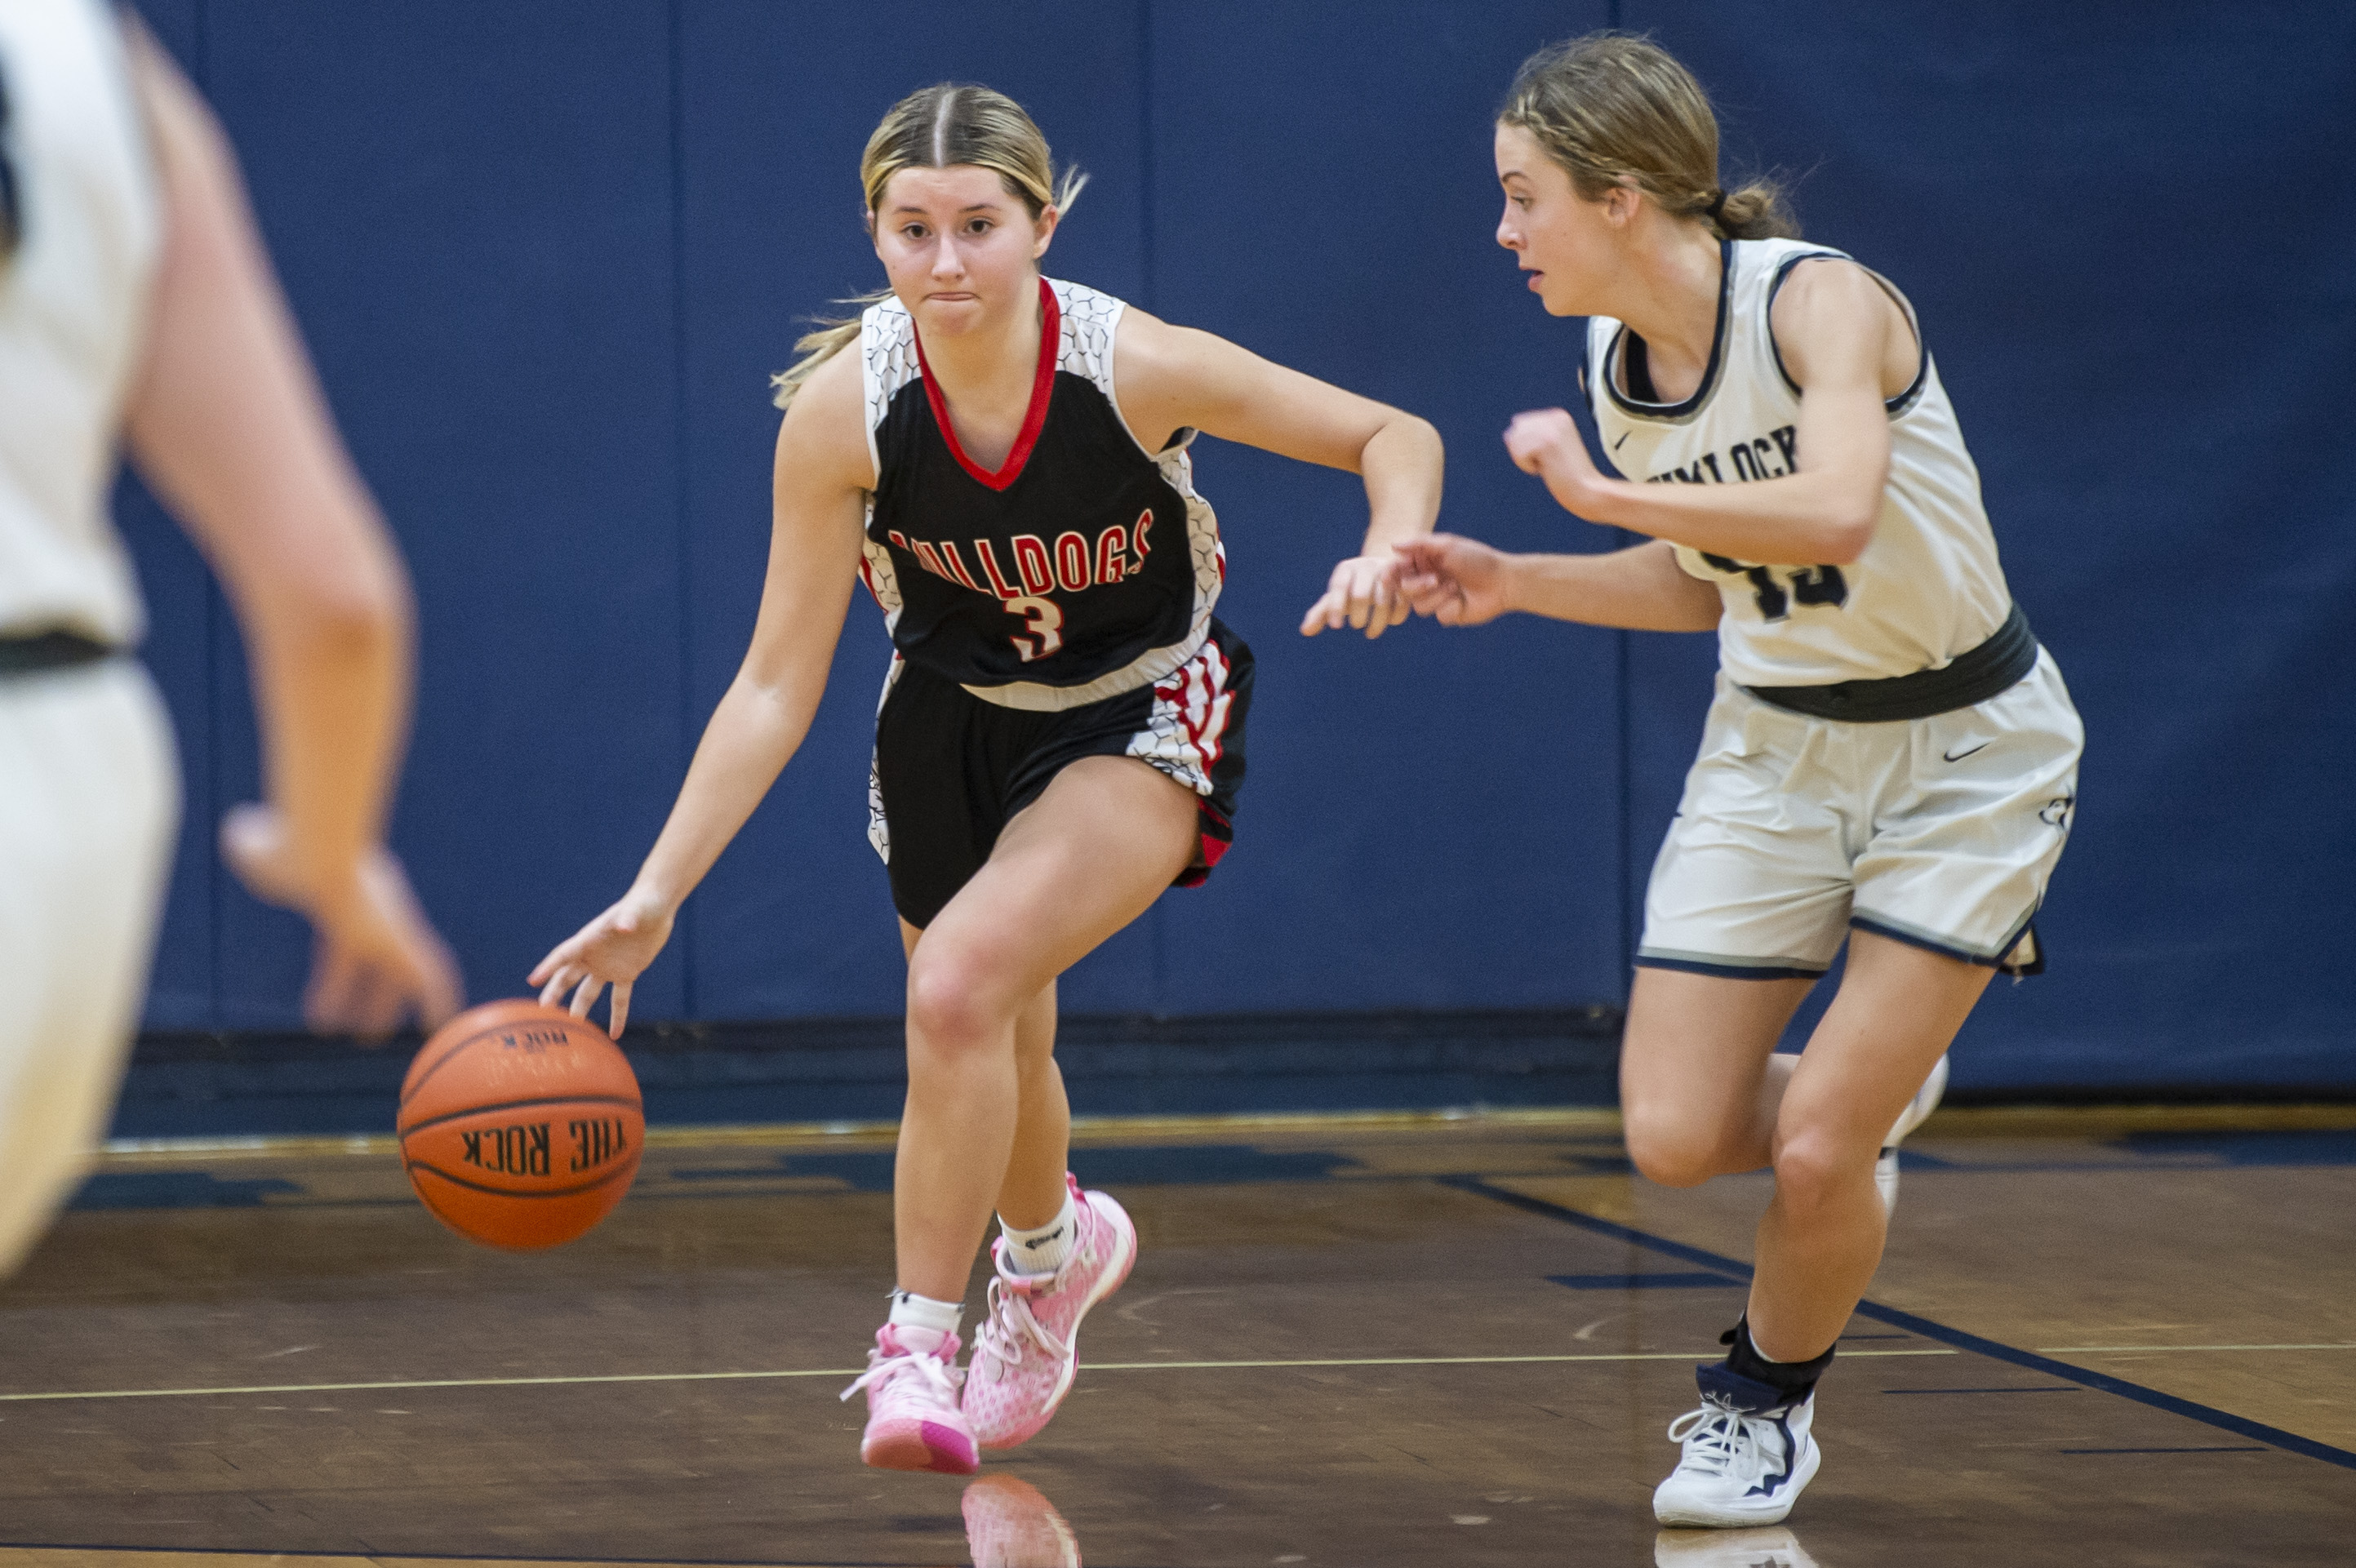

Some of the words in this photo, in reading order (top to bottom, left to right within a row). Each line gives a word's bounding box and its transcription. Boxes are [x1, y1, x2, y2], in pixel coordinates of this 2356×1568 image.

[1645, 424, 1798, 484] LOCK
[888, 508, 1154, 602] ULLDOGS
[1002, 596, 1065, 663] 3
[460, 1122, 552, 1177] ROCK
[568, 1117, 628, 1174] THE
